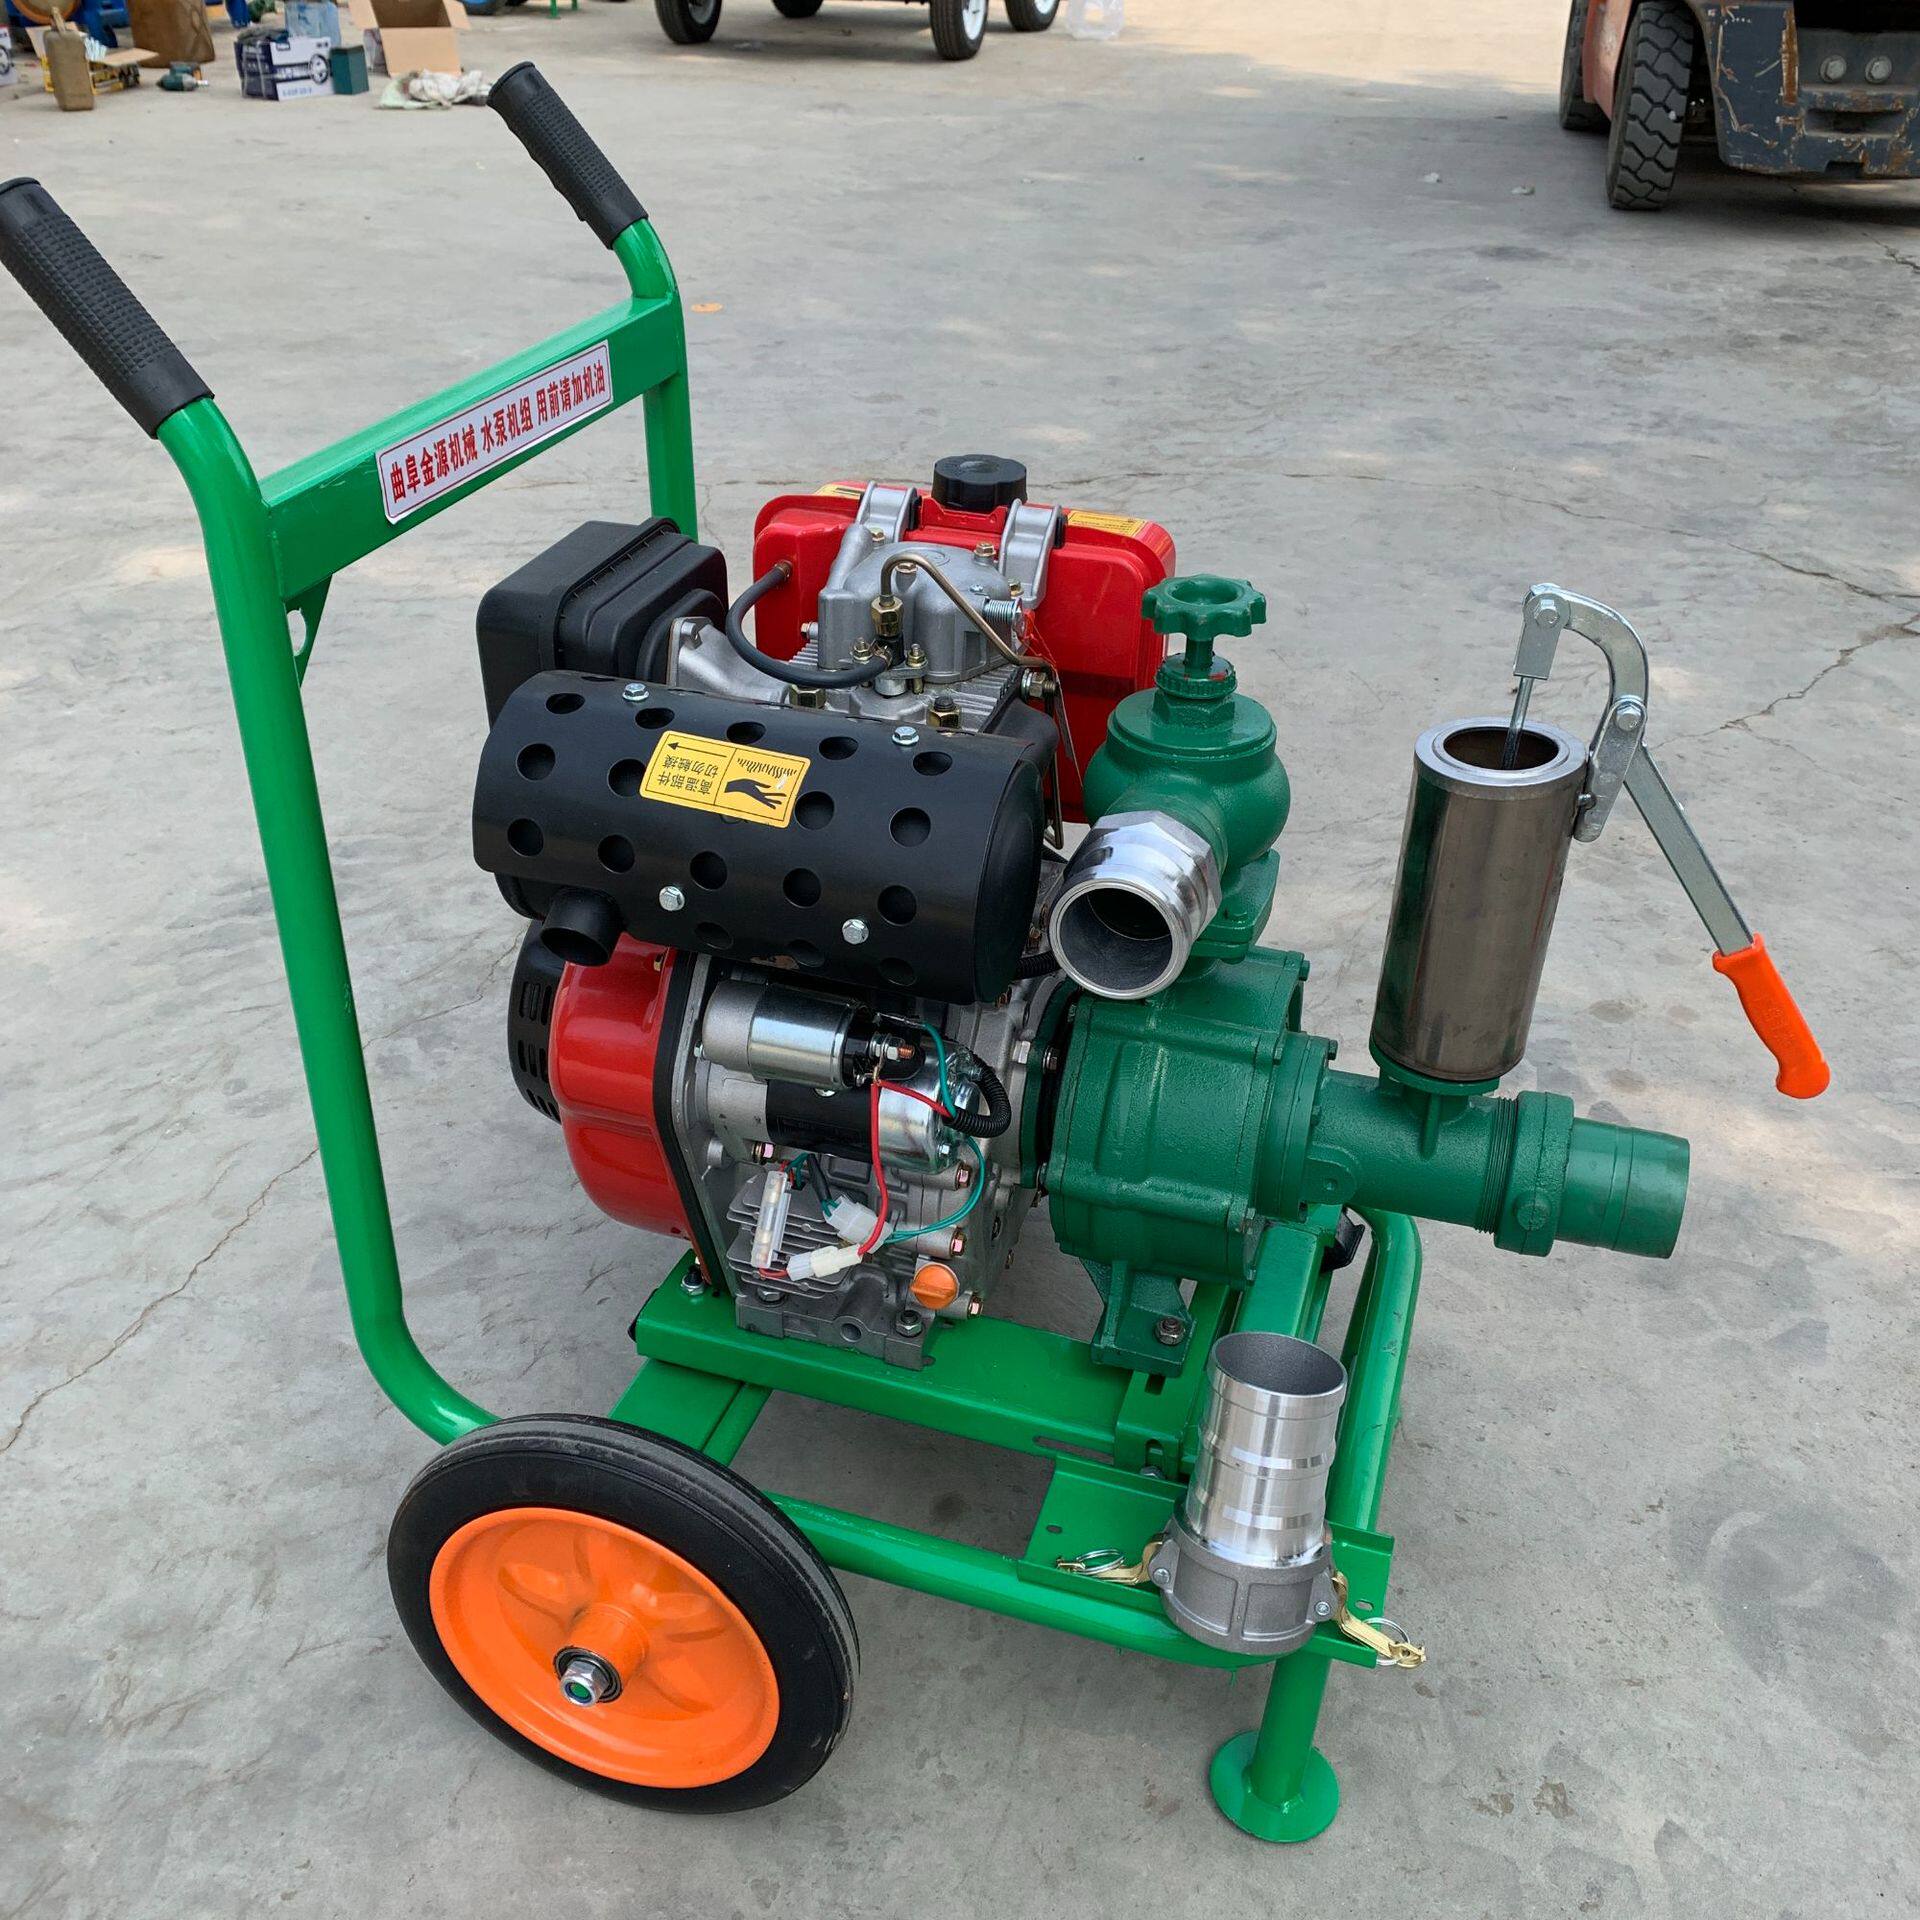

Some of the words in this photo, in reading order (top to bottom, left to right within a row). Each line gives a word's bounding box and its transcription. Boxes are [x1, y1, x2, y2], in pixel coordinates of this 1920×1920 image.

[390, 424, 478, 502] 曲阜金源机械
[481, 396, 533, 453] 水泵机组
[536, 360, 605, 425] 用前请加机油
[657, 771, 713, 795] 高温部件
